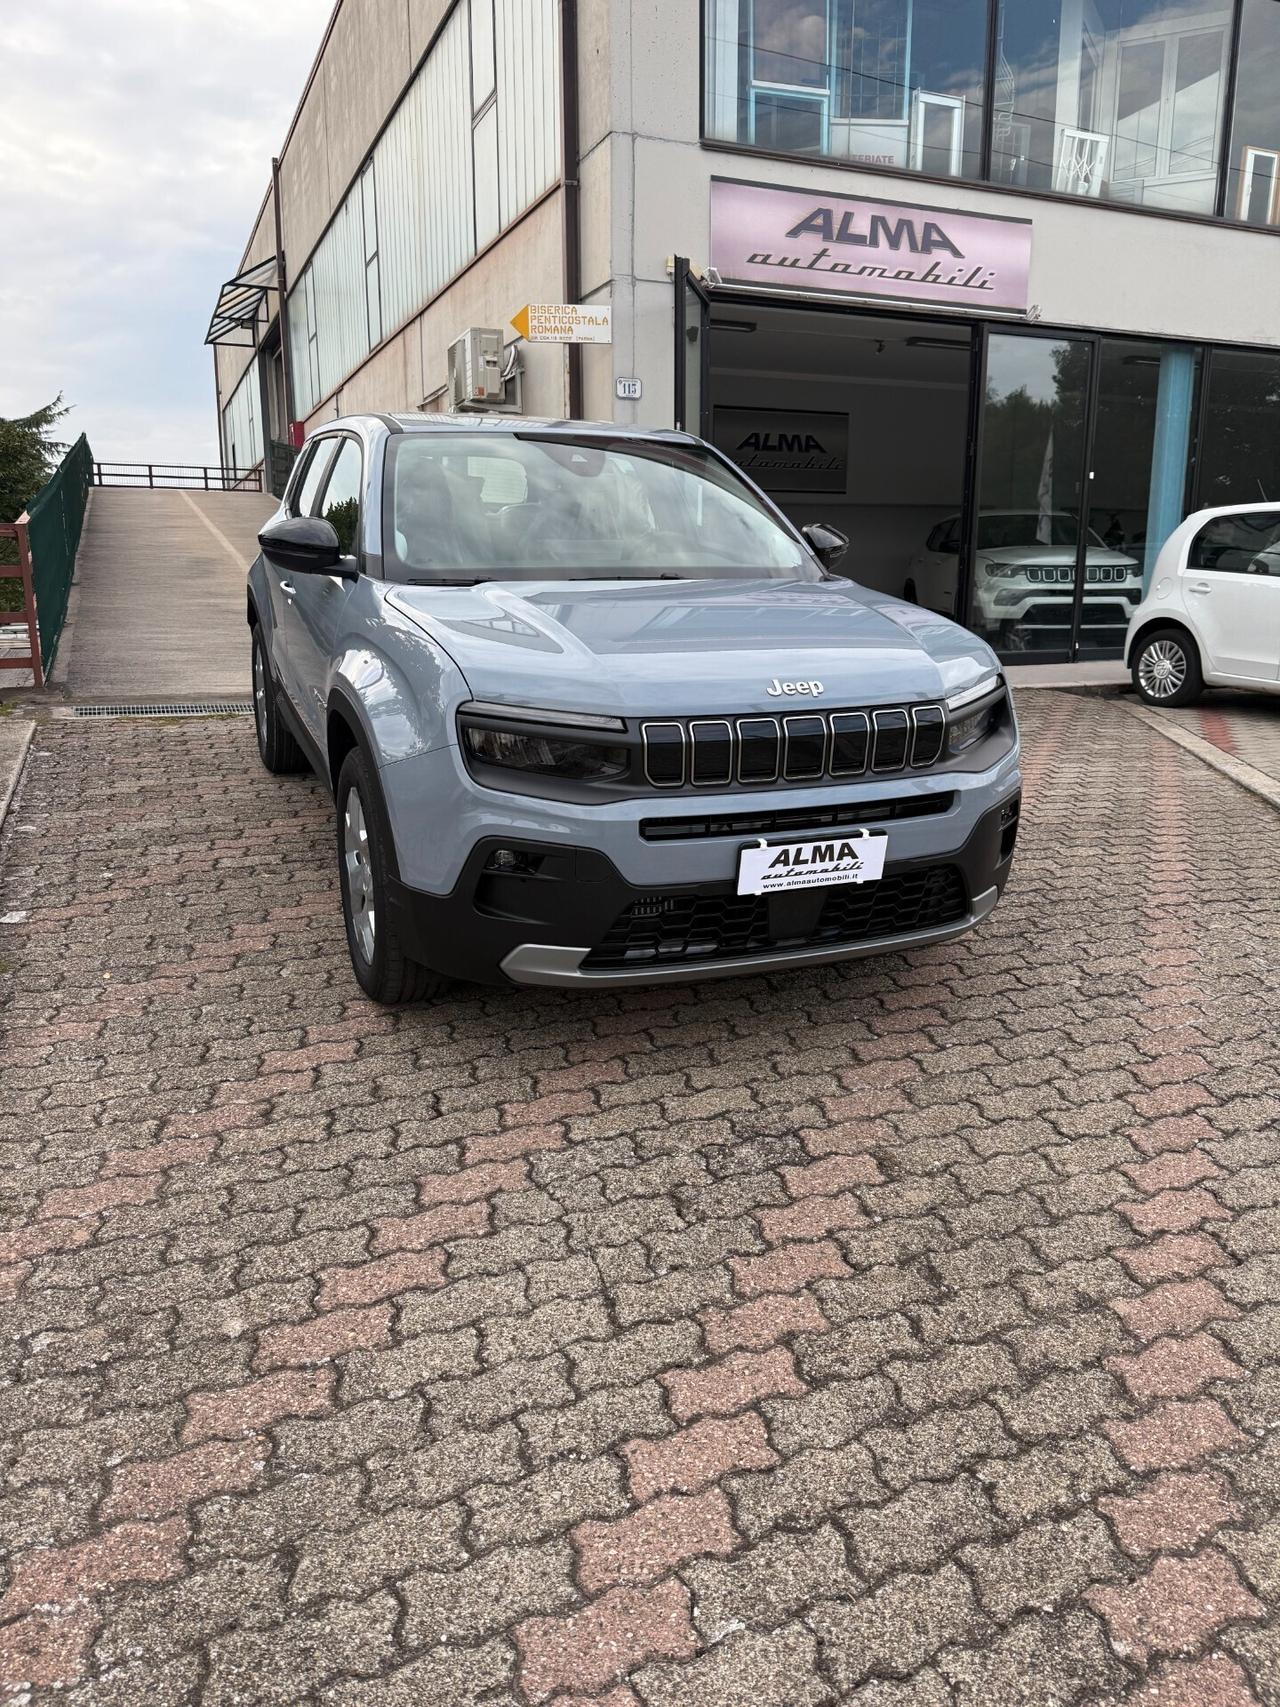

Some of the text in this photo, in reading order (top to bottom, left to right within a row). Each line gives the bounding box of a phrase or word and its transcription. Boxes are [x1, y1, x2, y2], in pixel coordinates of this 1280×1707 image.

[785, 207, 965, 259] ALMA
[746, 248, 994, 291] automobili
[530, 305, 578, 315] BISERICA
[530, 315, 609, 326] PENTICOSTALA
[530, 325, 574, 335] ROMANA
[623, 383, 637, 395] 115
[736, 432, 828, 454] ALMA
[766, 679, 824, 698] Jeep
[768, 842, 859, 869] ALMA
[761, 861, 865, 880] automobili
[763, 873, 858, 889] www.almaautomobili.it
